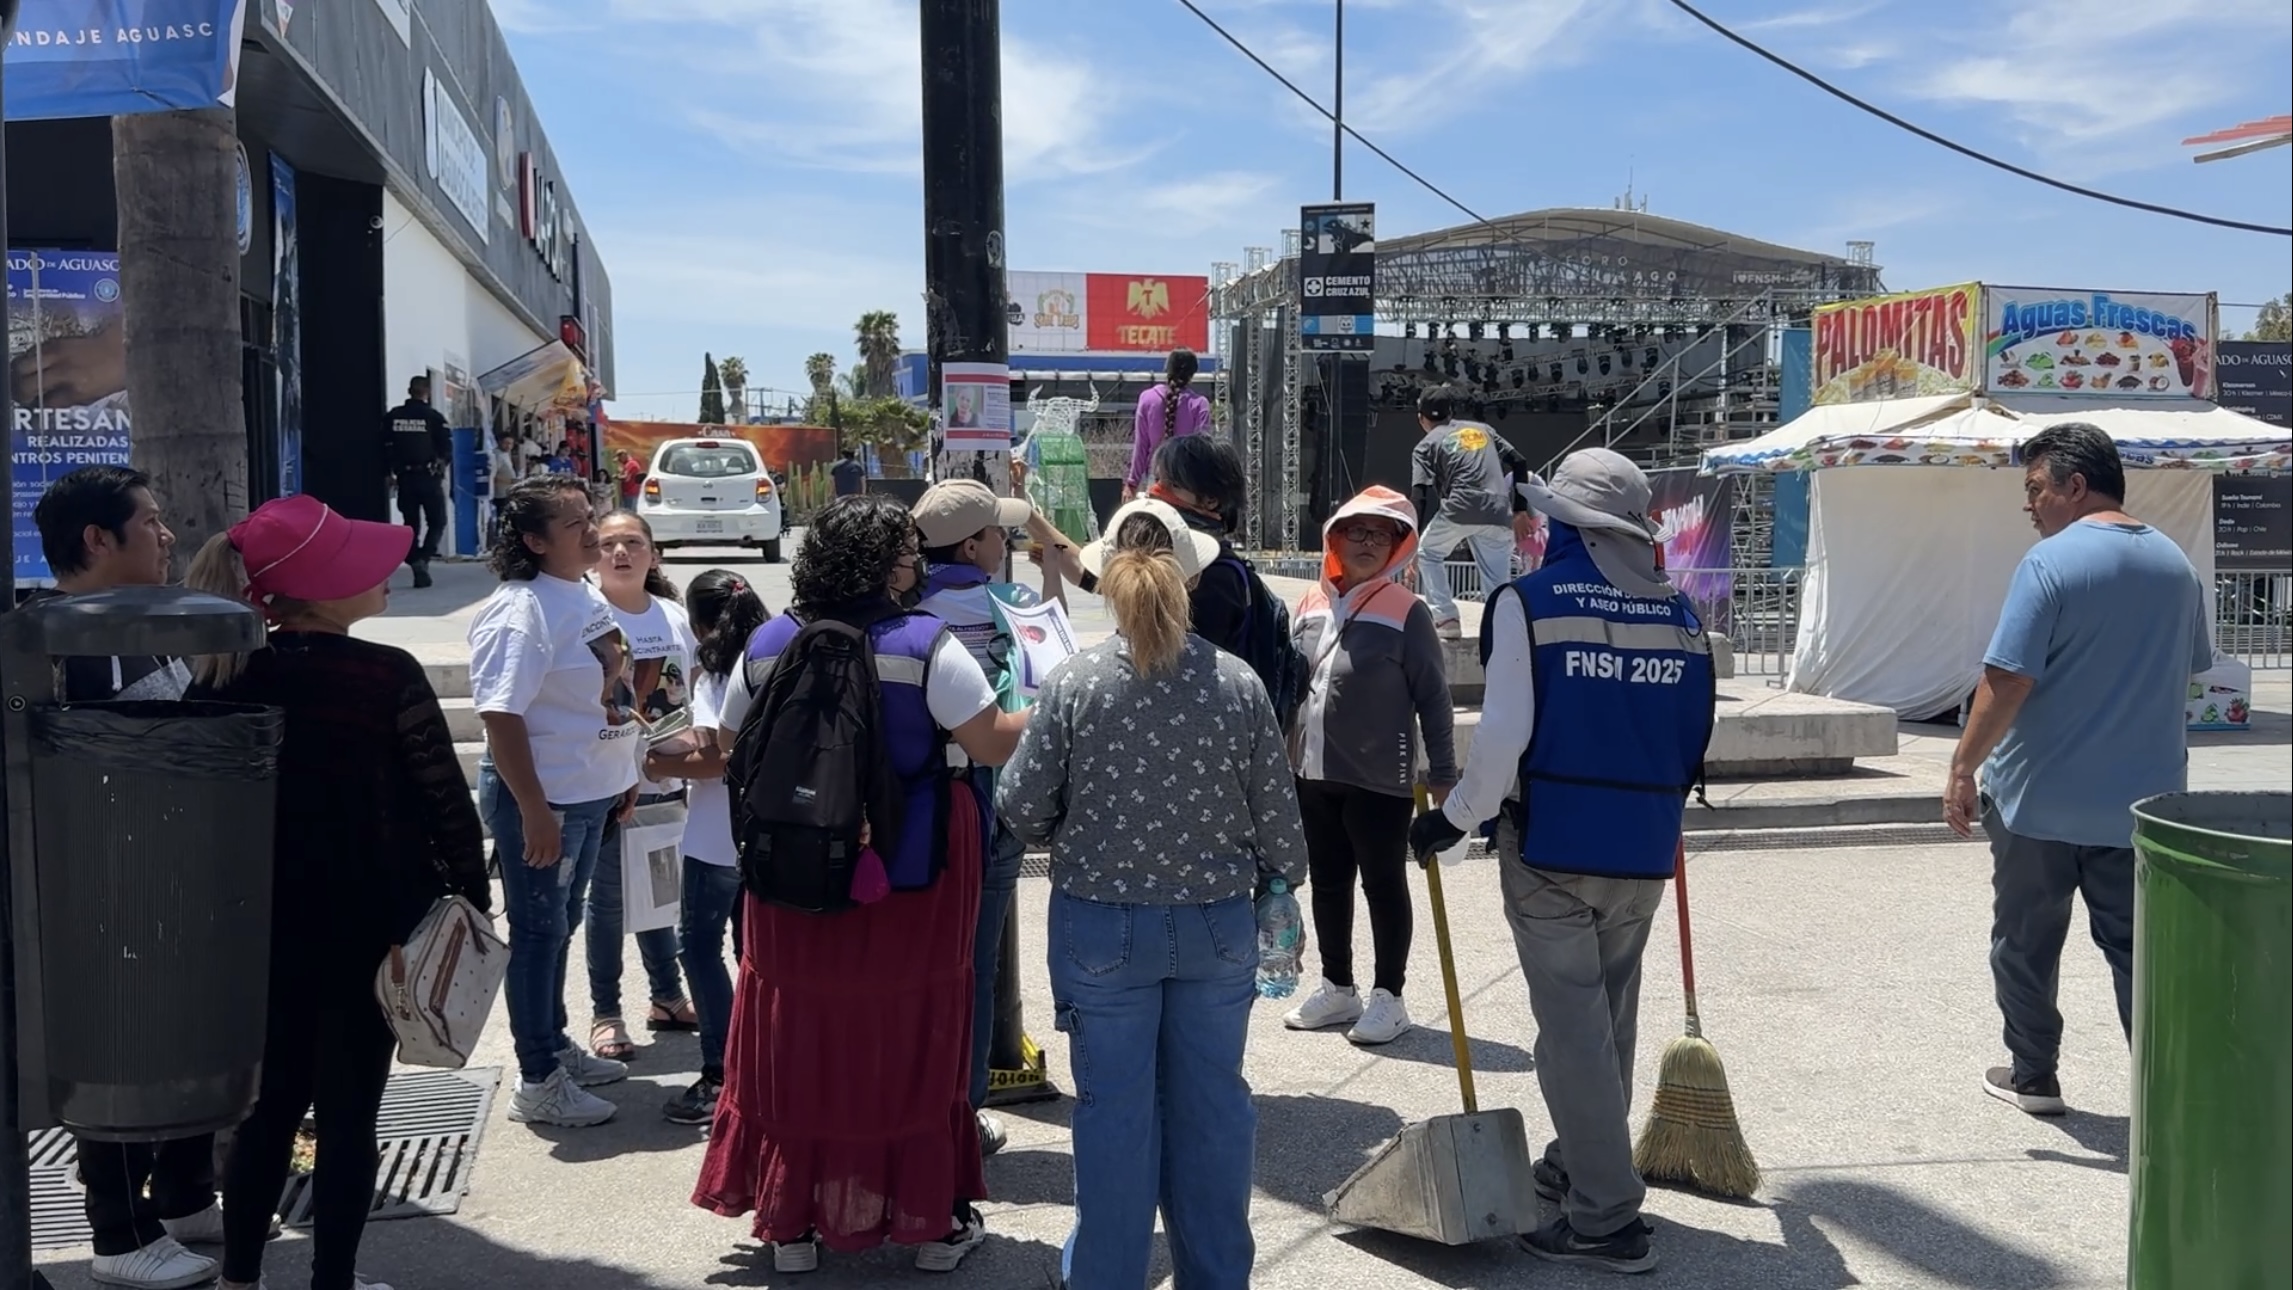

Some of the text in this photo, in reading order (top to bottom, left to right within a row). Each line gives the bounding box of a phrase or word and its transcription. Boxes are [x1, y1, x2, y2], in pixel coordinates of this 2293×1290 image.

[8, 22, 213, 46] NDAJE AGUASC
[1326, 275, 1371, 286] CEMENTO
[1326, 287, 1371, 297] CRUZ AZUL
[2000, 291, 2198, 344] Aguas Frescas
[1116, 325, 1177, 345] TECATE
[1816, 290, 1967, 390] PALOMITAS
[11, 408, 130, 431] RTESAN
[27, 436, 128, 448] REALIZADAS
[66, 452, 129, 464] PENITEN
[1553, 583, 1623, 598] DIRECCIÓN
[1575, 597, 1671, 617] Y ASEO PÚBLICO
[1630, 657, 1685, 685] 2025
